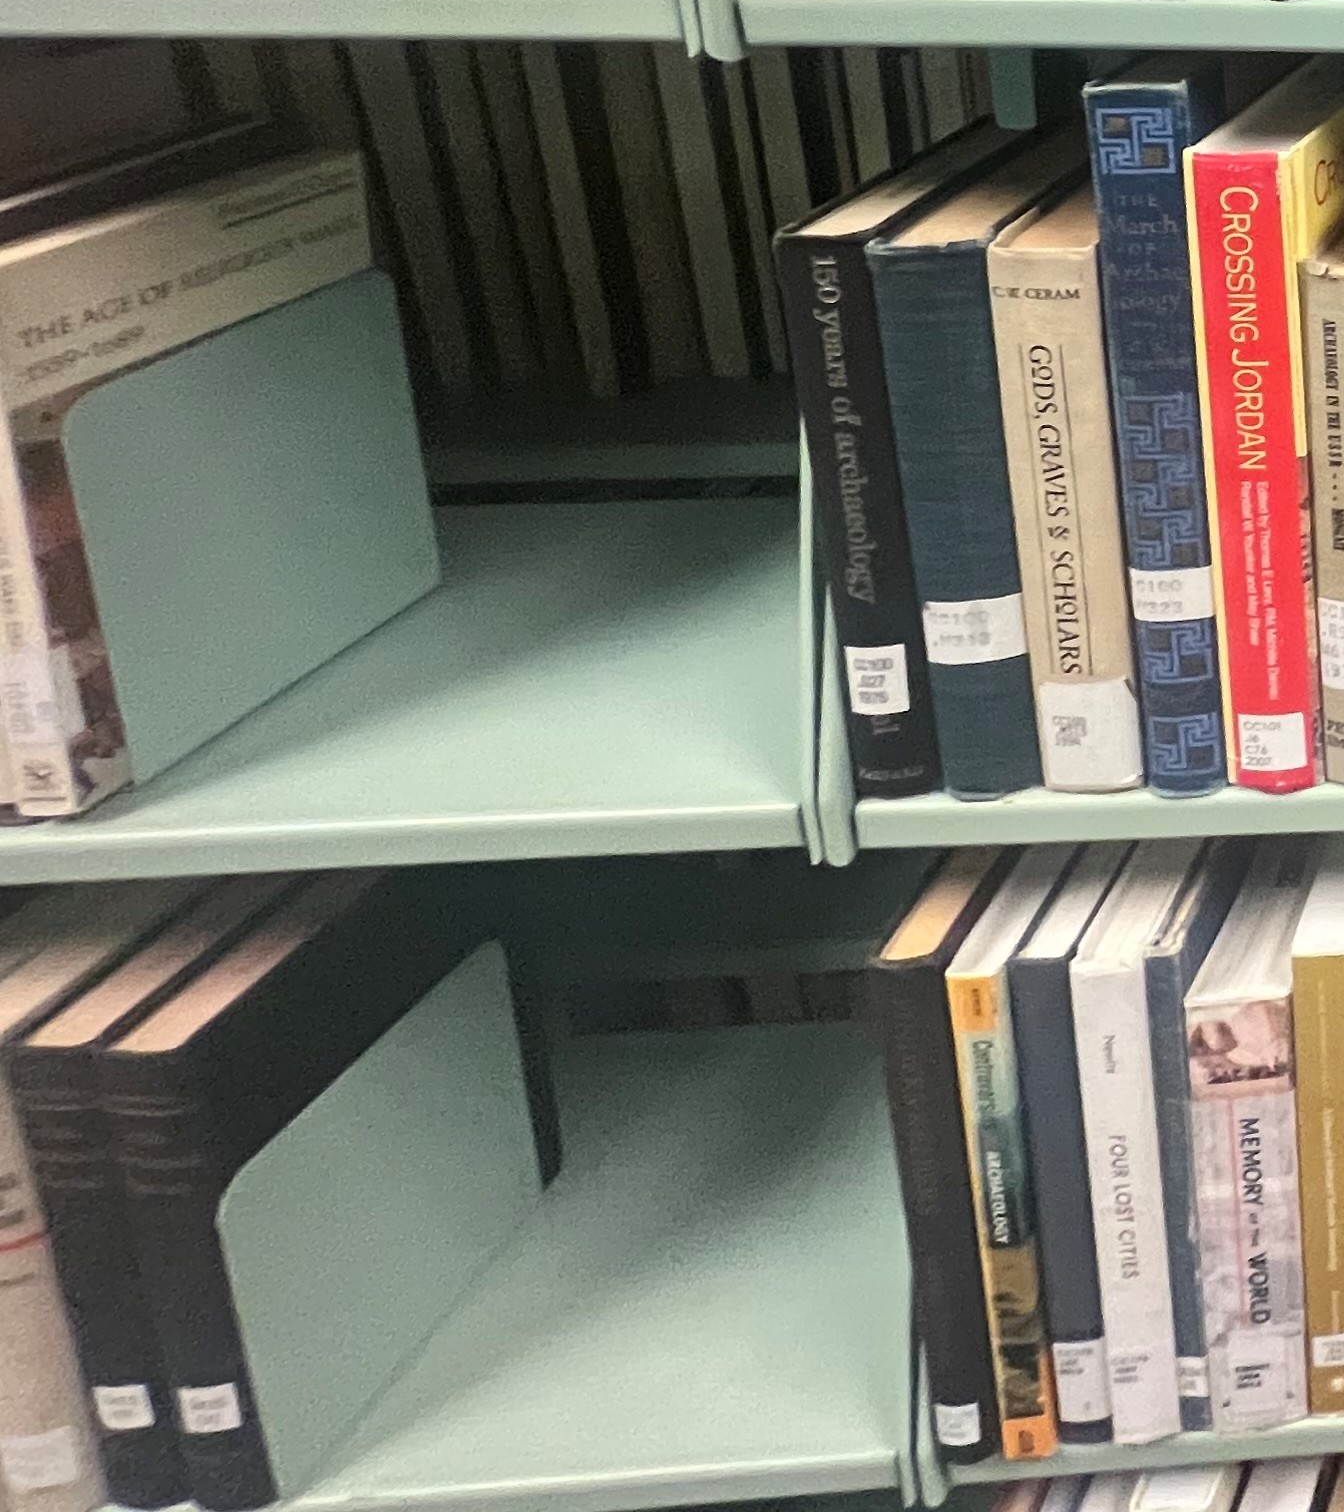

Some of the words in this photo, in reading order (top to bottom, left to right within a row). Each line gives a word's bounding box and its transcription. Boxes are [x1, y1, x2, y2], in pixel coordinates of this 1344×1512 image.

[1219, 185, 1259, 343] CROSSING
[1027, 343, 1058, 420] GODS,
[1230, 346, 1269, 470] JORDAN
[1036, 423, 1070, 518] GRAVES
[1046, 524, 1071, 541] &
[1049, 549, 1083, 675] SCHOLARS
